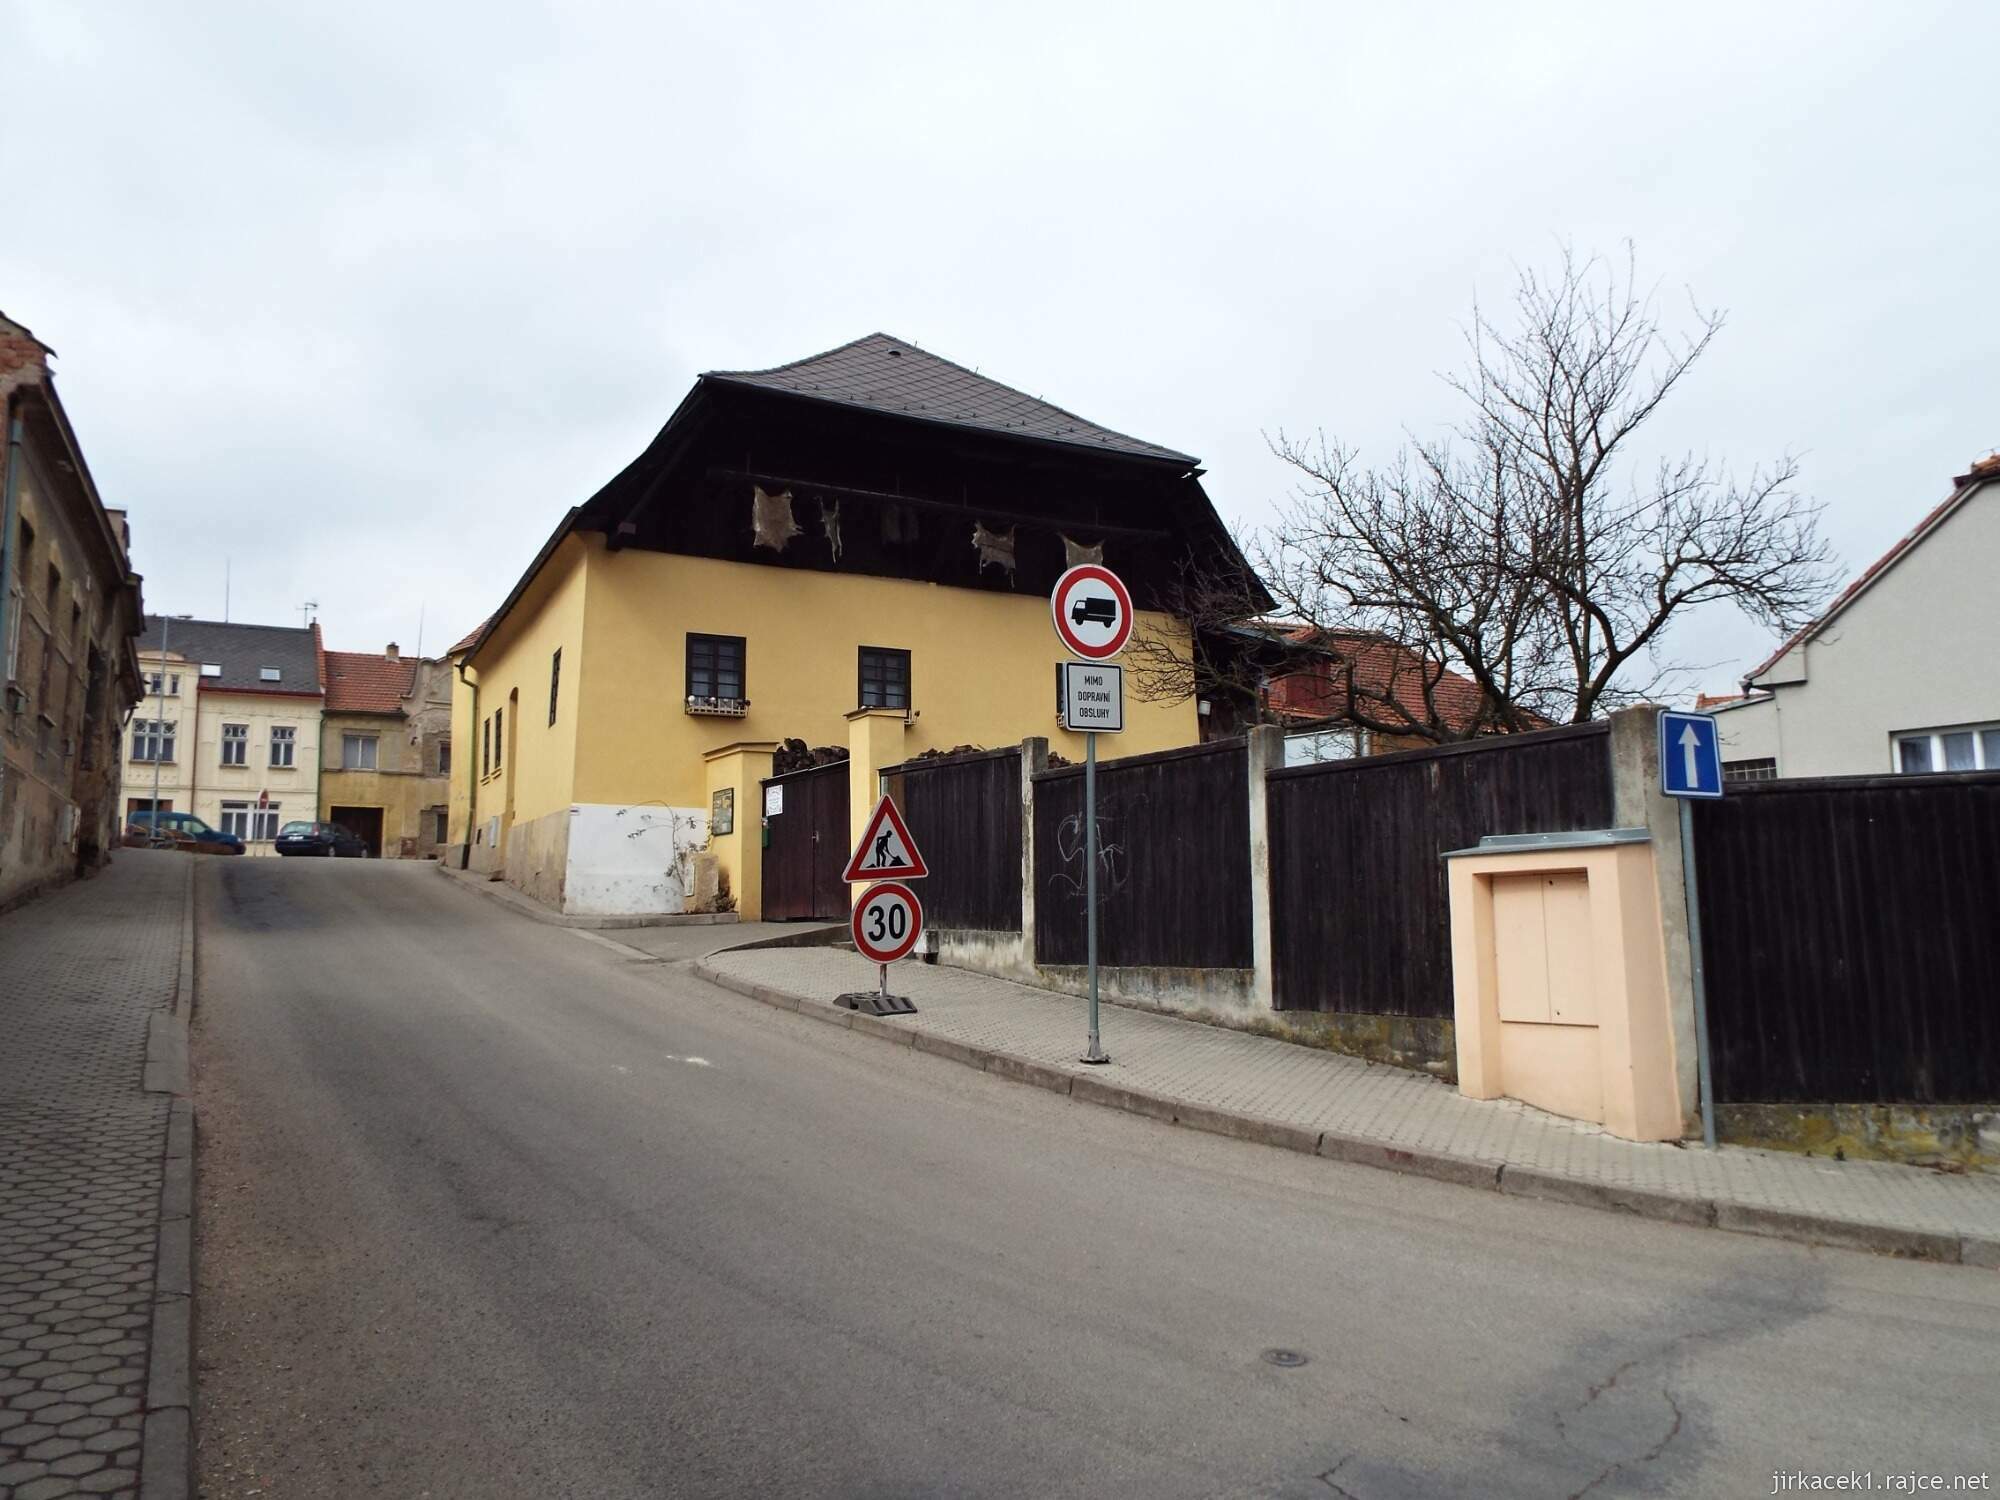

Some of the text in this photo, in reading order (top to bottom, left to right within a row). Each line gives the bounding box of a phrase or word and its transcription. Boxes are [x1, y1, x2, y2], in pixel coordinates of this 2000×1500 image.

[1084, 675, 1103, 686] MIMO
[1077, 690, 1111, 703] DOPRAVNÍ
[1079, 707, 1110, 719] OBSLUHY
[868, 903, 906, 942] 30
